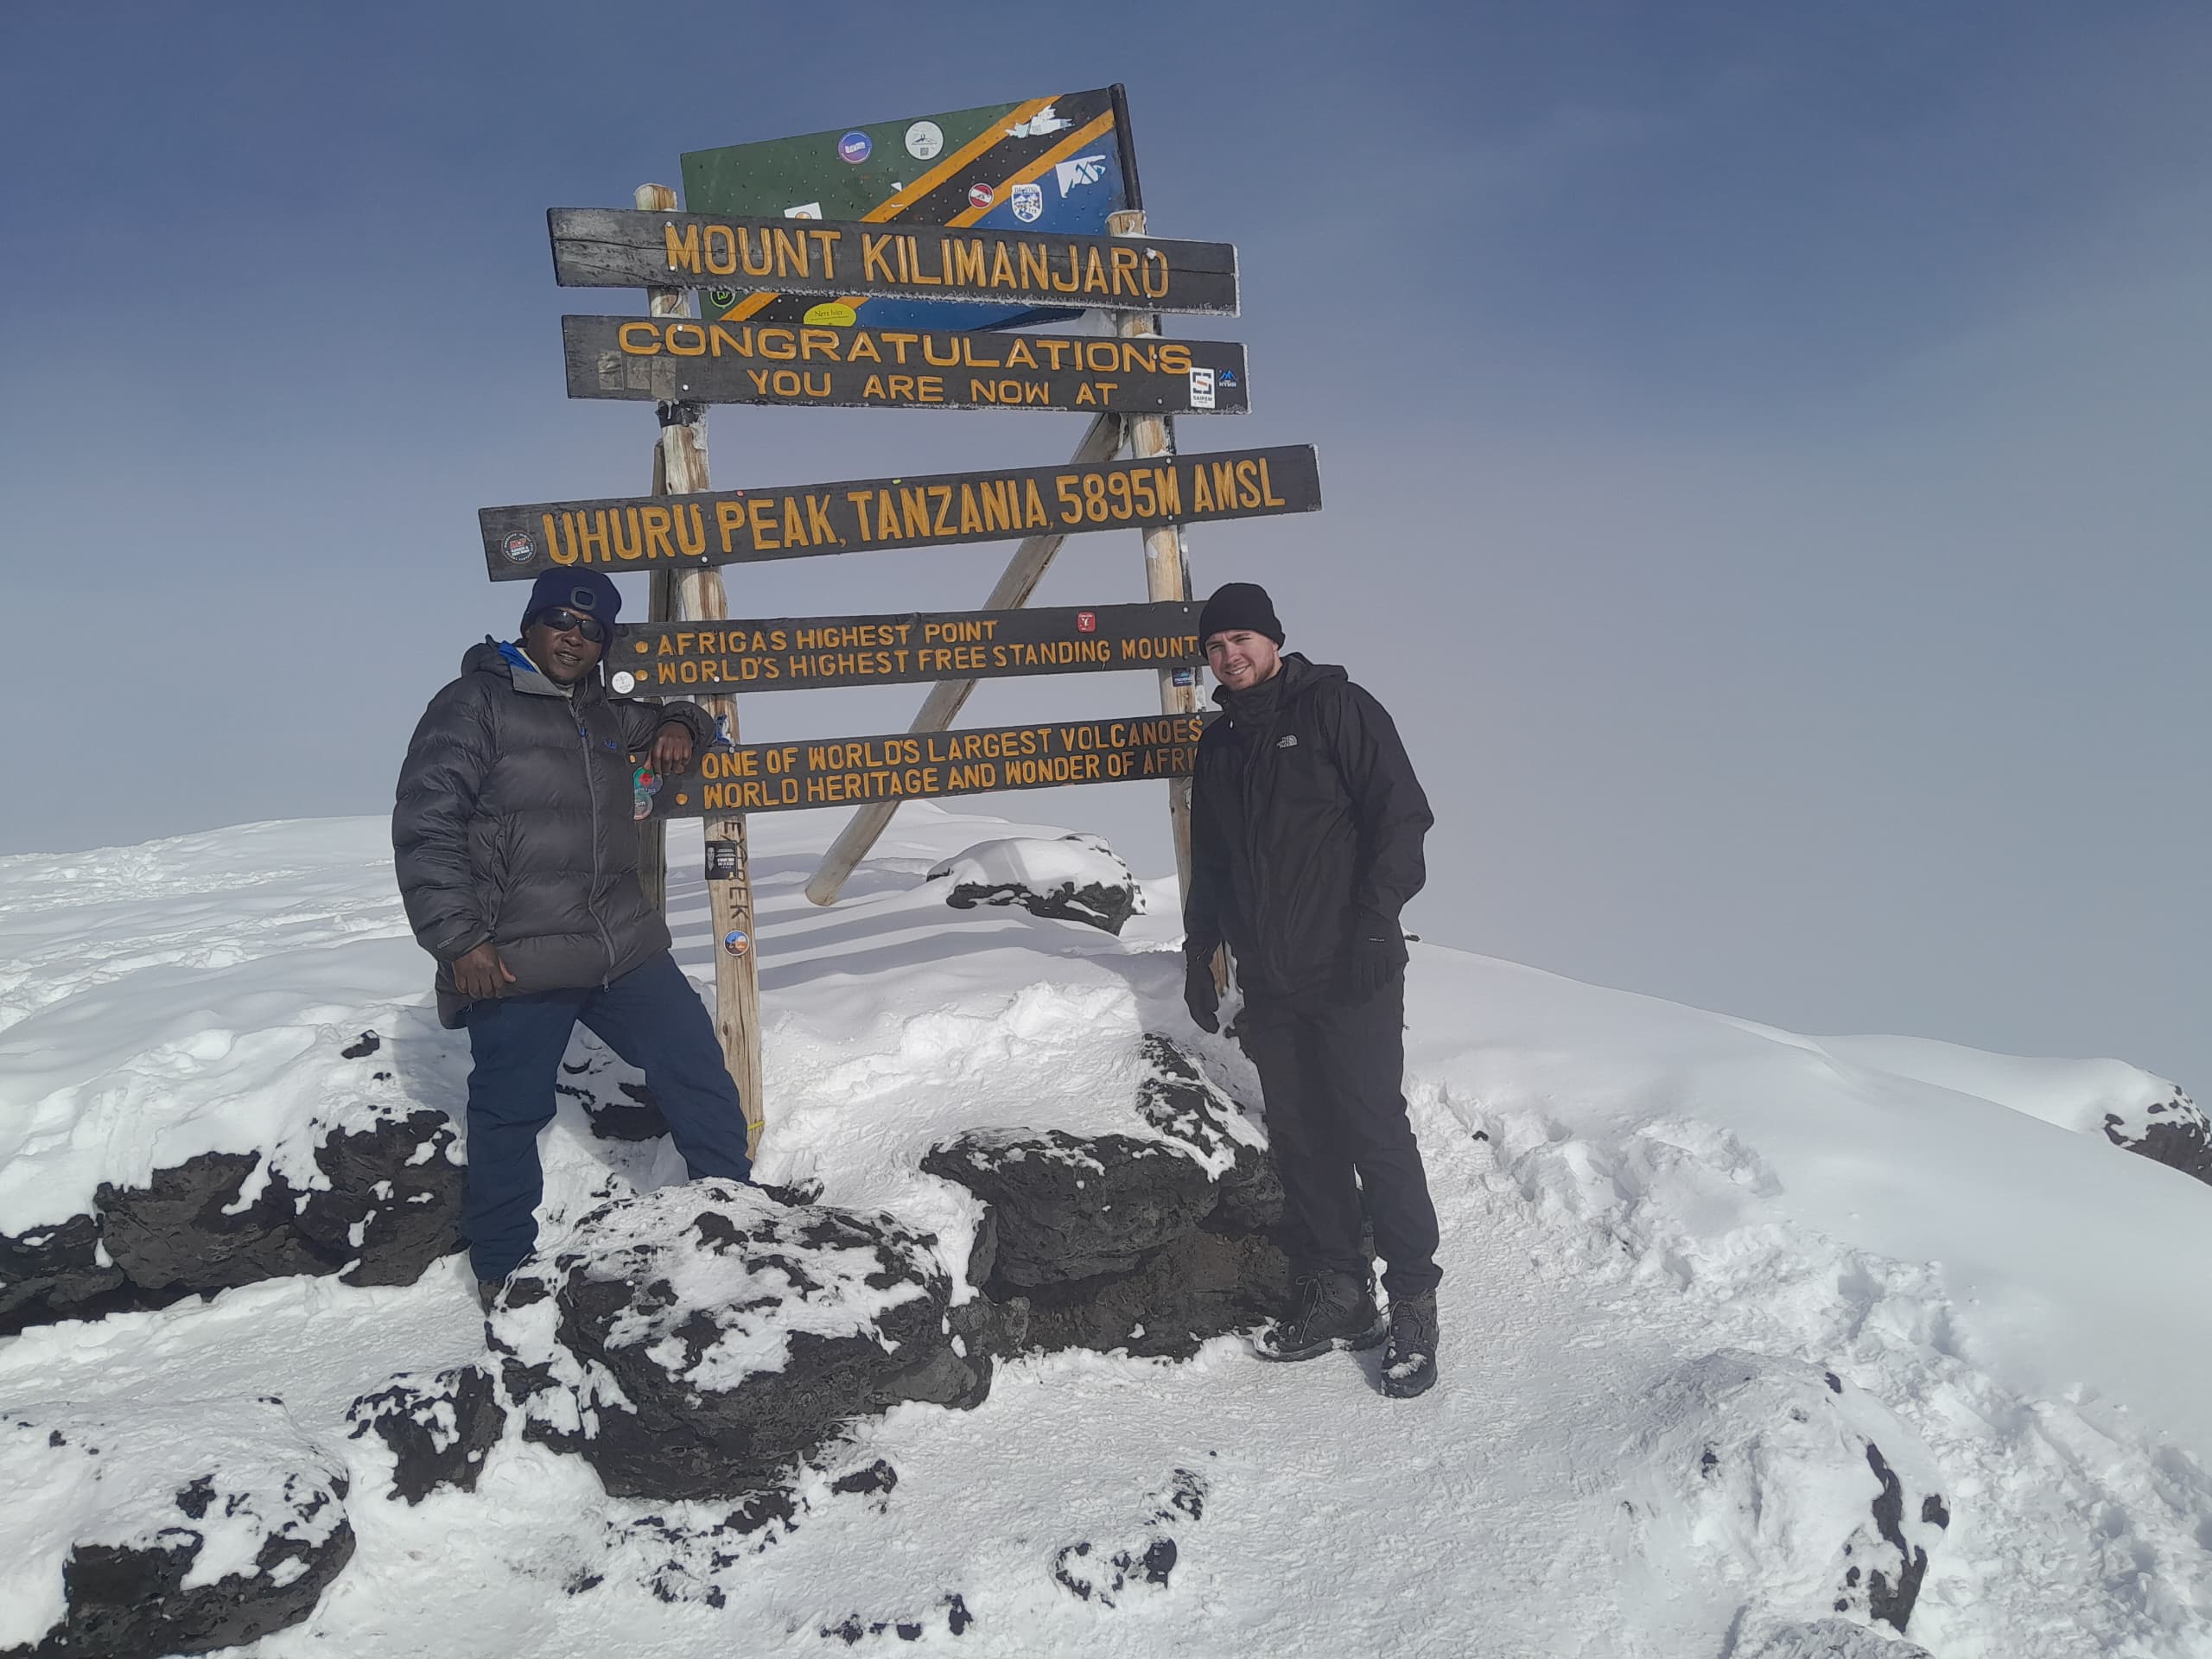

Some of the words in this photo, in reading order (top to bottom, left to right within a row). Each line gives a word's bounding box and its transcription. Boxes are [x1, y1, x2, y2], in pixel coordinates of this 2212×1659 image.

[664, 224, 841, 279] MOUNT
[861, 235, 1168, 297] KILIMANJARO
[619, 321, 1192, 374] CONGRATULATIONS
[747, 369, 831, 397] YOU
[863, 375, 944, 401] ARE
[970, 378, 1049, 404] NOW
[1077, 383, 1118, 405] AT
[543, 504, 706, 565] UHURU
[715, 494, 846, 552] PEAK,
[847, 479, 1054, 542] TANZANIA,
[1056, 467, 1181, 524] 5895M
[1194, 459, 1285, 512] AMSL
[658, 658, 779, 683] WORLD'S
[789, 650, 909, 677] HIGHEST
[918, 645, 987, 670] FREE
[993, 640, 1110, 666] STANDING
[1122, 635, 1202, 660] MOUNT
[796, 624, 911, 650] HIGHEST
[925, 620, 996, 644] POINT
[702, 750, 759, 779] ONE
[766, 747, 798, 773] OF
[808, 739, 920, 771] WORLD'S
[927, 728, 1052, 762] LARGEST
[1061, 719, 1203, 752] VOLCANOES
[704, 779, 798, 809] WORLD
[807, 767, 939, 802] HERITAGE
[947, 763, 995, 790] AND
[1005, 754, 1100, 785] WONDER
[1108, 752, 1133, 776] OF
[1142, 747, 1198, 775] AFRI
